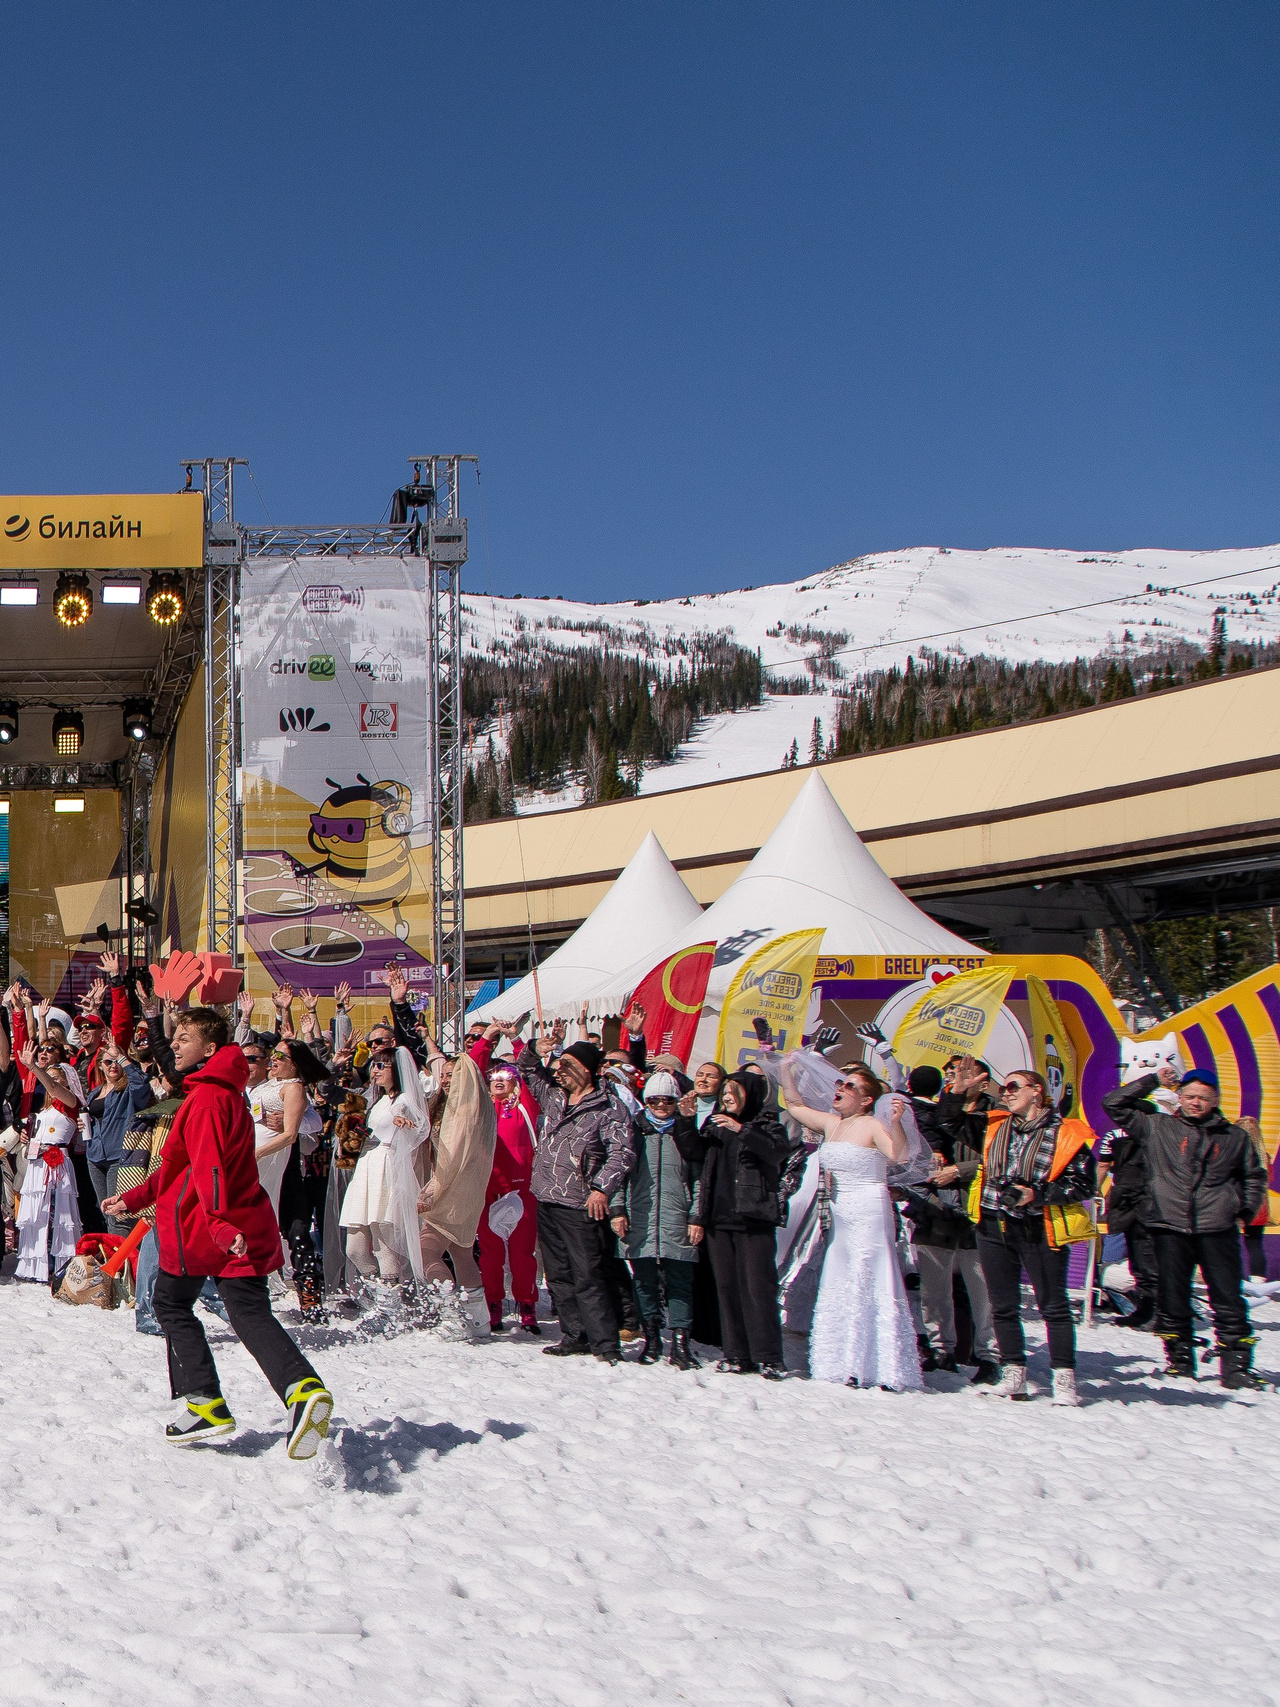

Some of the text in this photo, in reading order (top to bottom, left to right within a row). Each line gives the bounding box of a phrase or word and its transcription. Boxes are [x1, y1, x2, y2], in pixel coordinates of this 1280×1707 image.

[38, 514, 142, 539] билайн
[308, 588, 339, 599] GRELKA
[308, 600, 329, 609] FEST
[269, 656, 336, 677] drivee
[948, 957, 985, 974] EST
